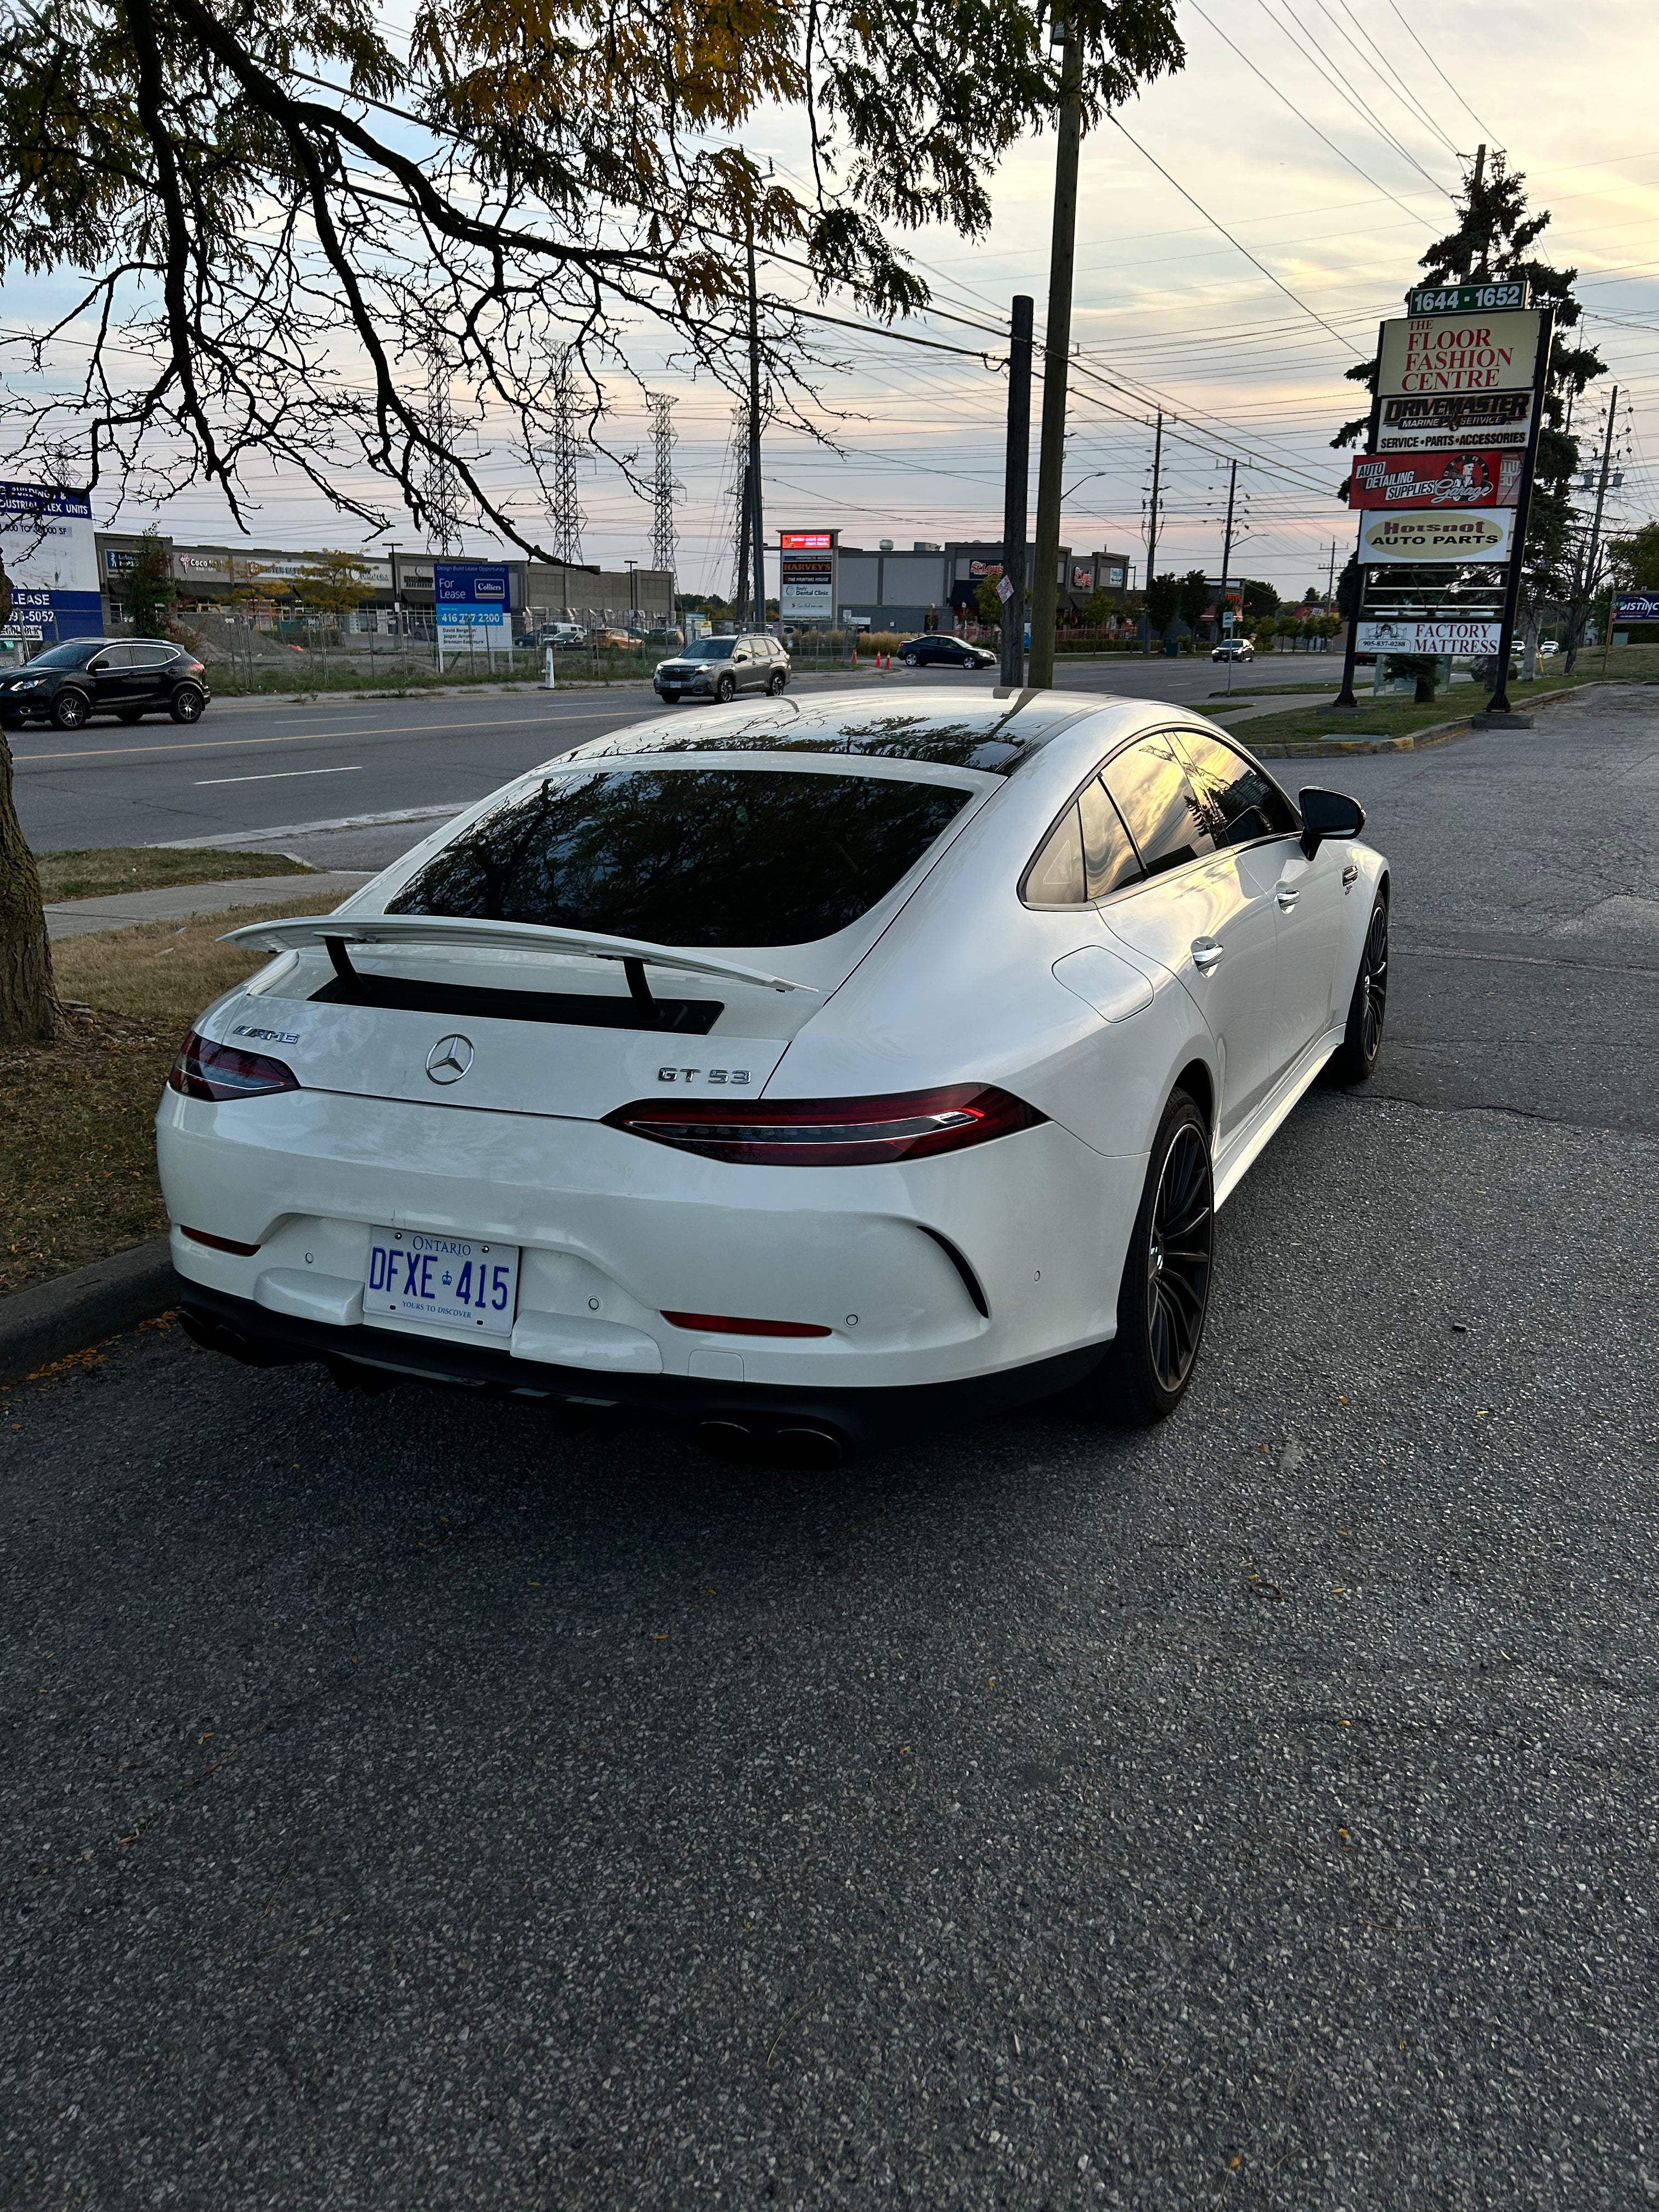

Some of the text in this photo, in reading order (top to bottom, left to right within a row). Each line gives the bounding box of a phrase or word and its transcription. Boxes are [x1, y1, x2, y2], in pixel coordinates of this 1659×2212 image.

[1415, 291, 1459, 311] 1644
[1476, 286, 1520, 307] 1652
[1409, 320, 1434, 330] THE
[1406, 328, 1491, 351] FLOOR
[1404, 348, 1514, 371] FASHION
[1402, 369, 1499, 391] CENTRE
[1384, 394, 1529, 422] DRIVEMASTER
[1402, 416, 1503, 427] MARINE SERVICE
[1381, 432, 1526, 449] SERVICE PARTS ACCESSORIES
[1358, 463, 1384, 477] AUTO
[1365, 471, 1415, 489] DETAILING
[1388, 482, 1435, 499] SUPPLIES
[1431, 478, 1494, 504] Garage
[66, 505, 88, 514] UNITS
[1370, 535, 1498, 545] AUTO PARTS
[190, 558, 207, 567] Coco
[439, 578, 454, 588] For
[11, 593, 50, 605] LEASE
[440, 589, 466, 599] Lease
[442, 613, 458, 622] 416
[478, 613, 500, 622] 2200
[1415, 624, 1492, 638] FACTORY
[1413, 639, 1497, 653] MATTRESS
[658, 1067, 752, 1084] GT 53
[413, 1235, 471, 1257] ONTARIO
[369, 1247, 510, 1310] DFXE 415
[402, 1301, 424, 1310] YOURS
[438, 1307, 472, 1318] DISCOVER
